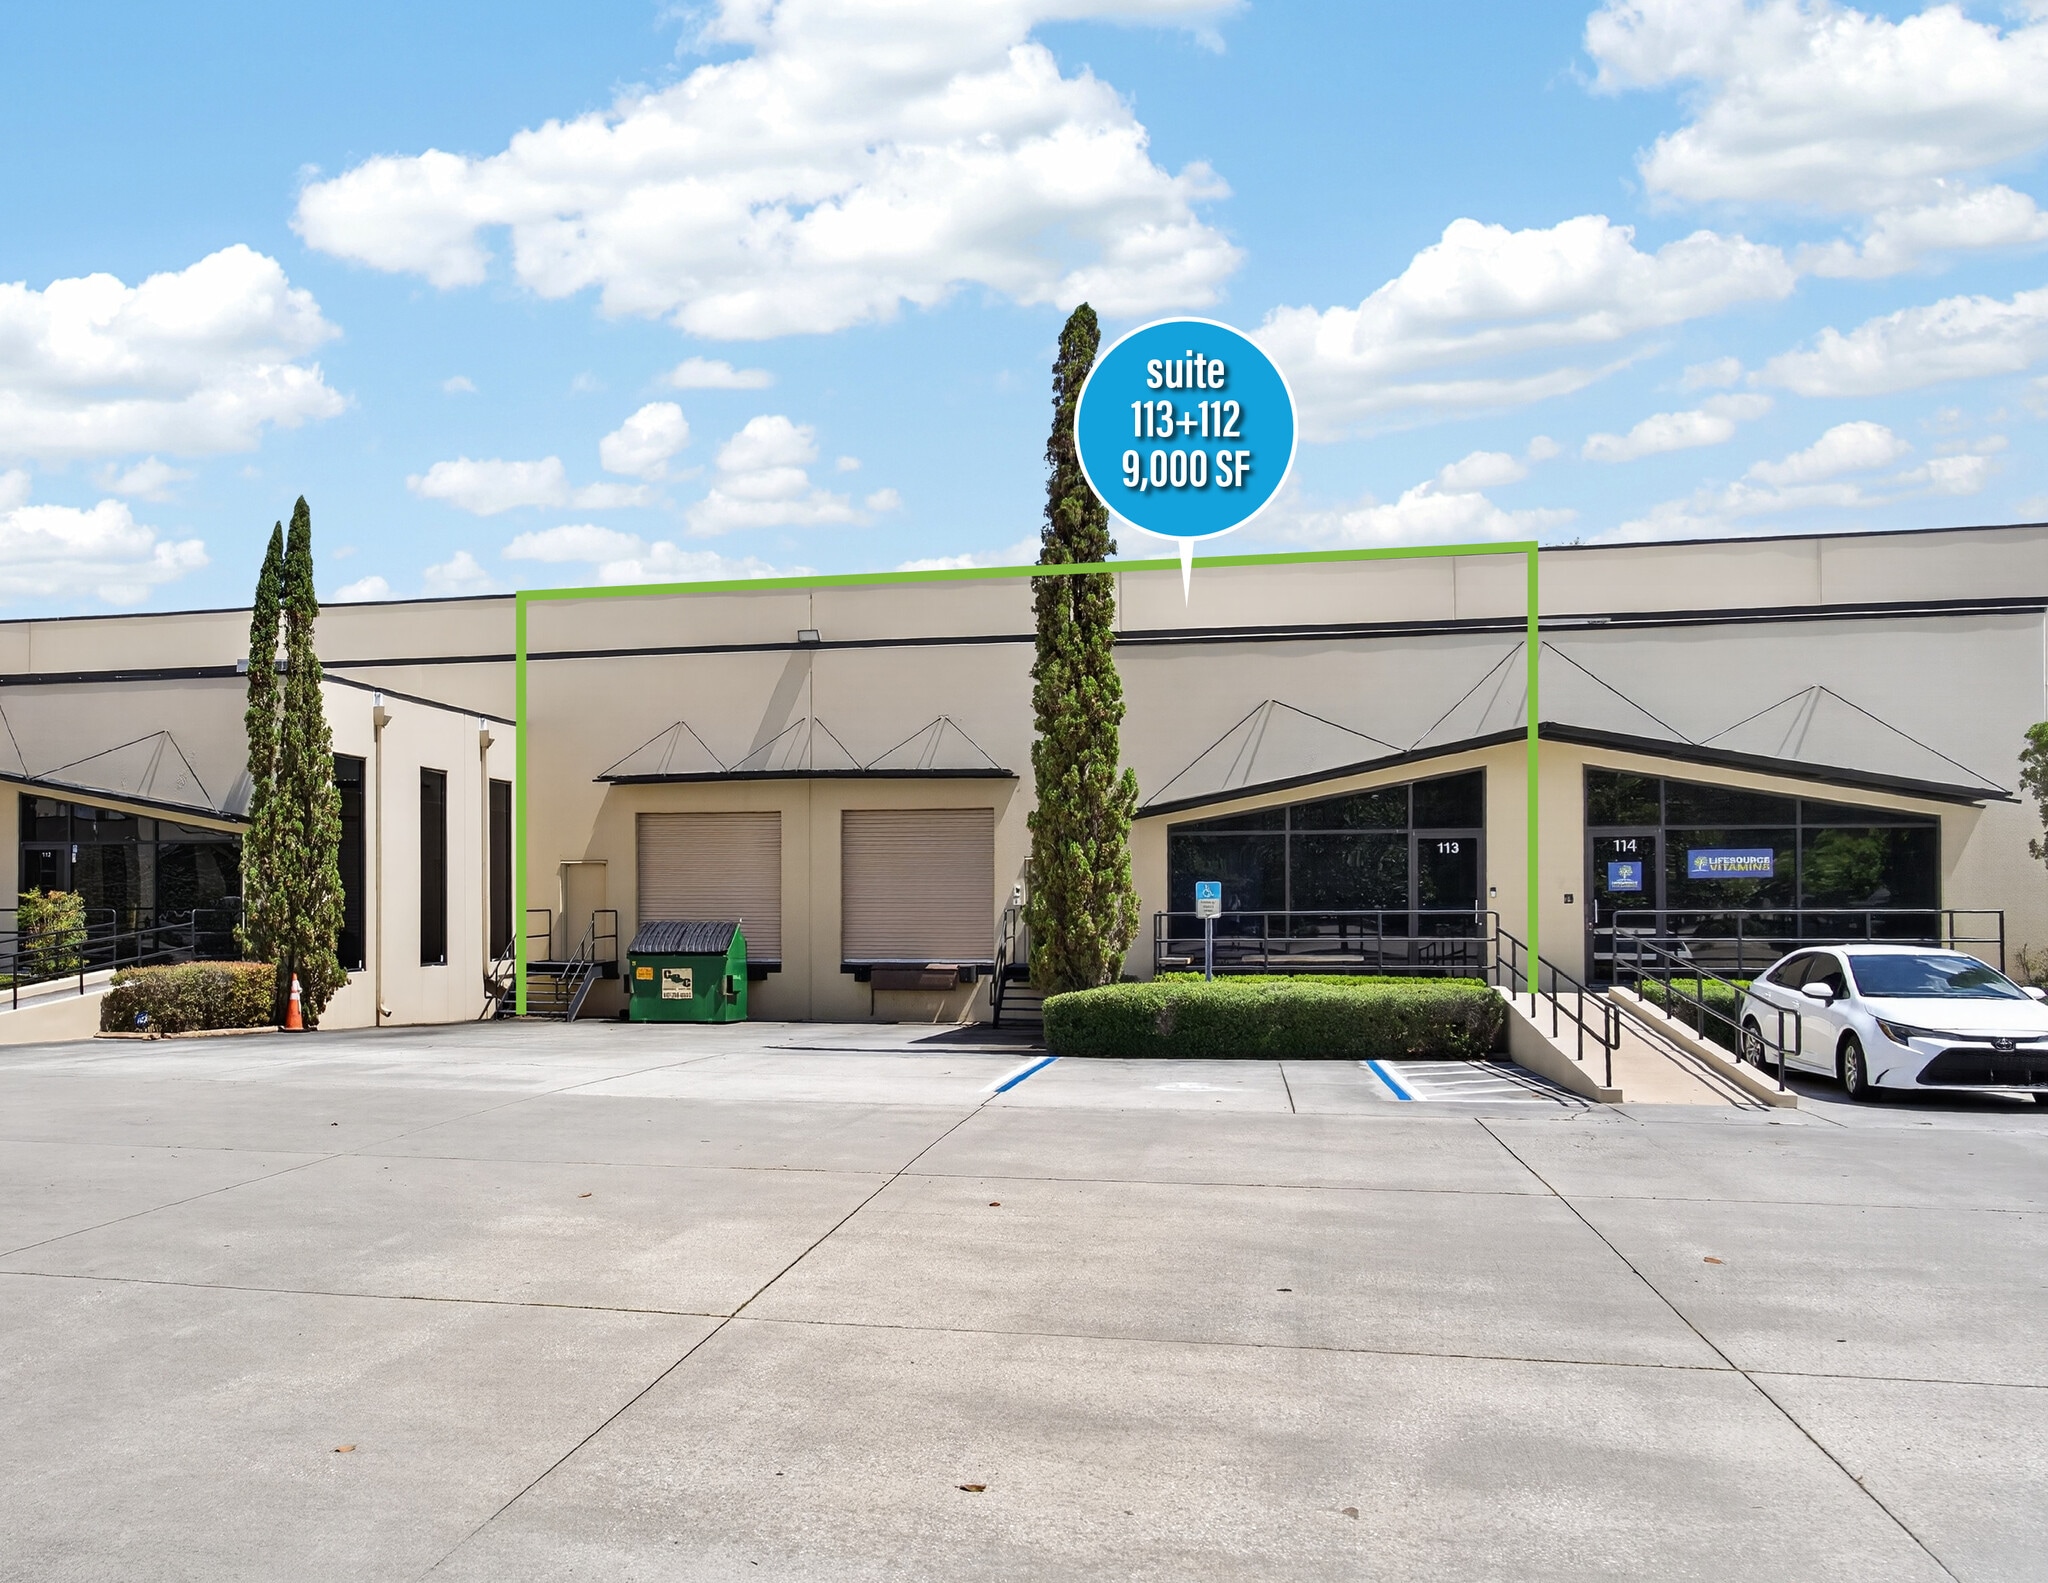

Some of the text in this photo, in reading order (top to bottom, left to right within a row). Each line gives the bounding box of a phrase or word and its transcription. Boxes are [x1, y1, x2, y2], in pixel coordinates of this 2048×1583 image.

[1437, 842, 1459, 854] 113
[1613, 840, 1637, 853] 114
[1708, 856, 1770, 864] LIFESOURCE
[1709, 863, 1770, 871] VITAMINS
